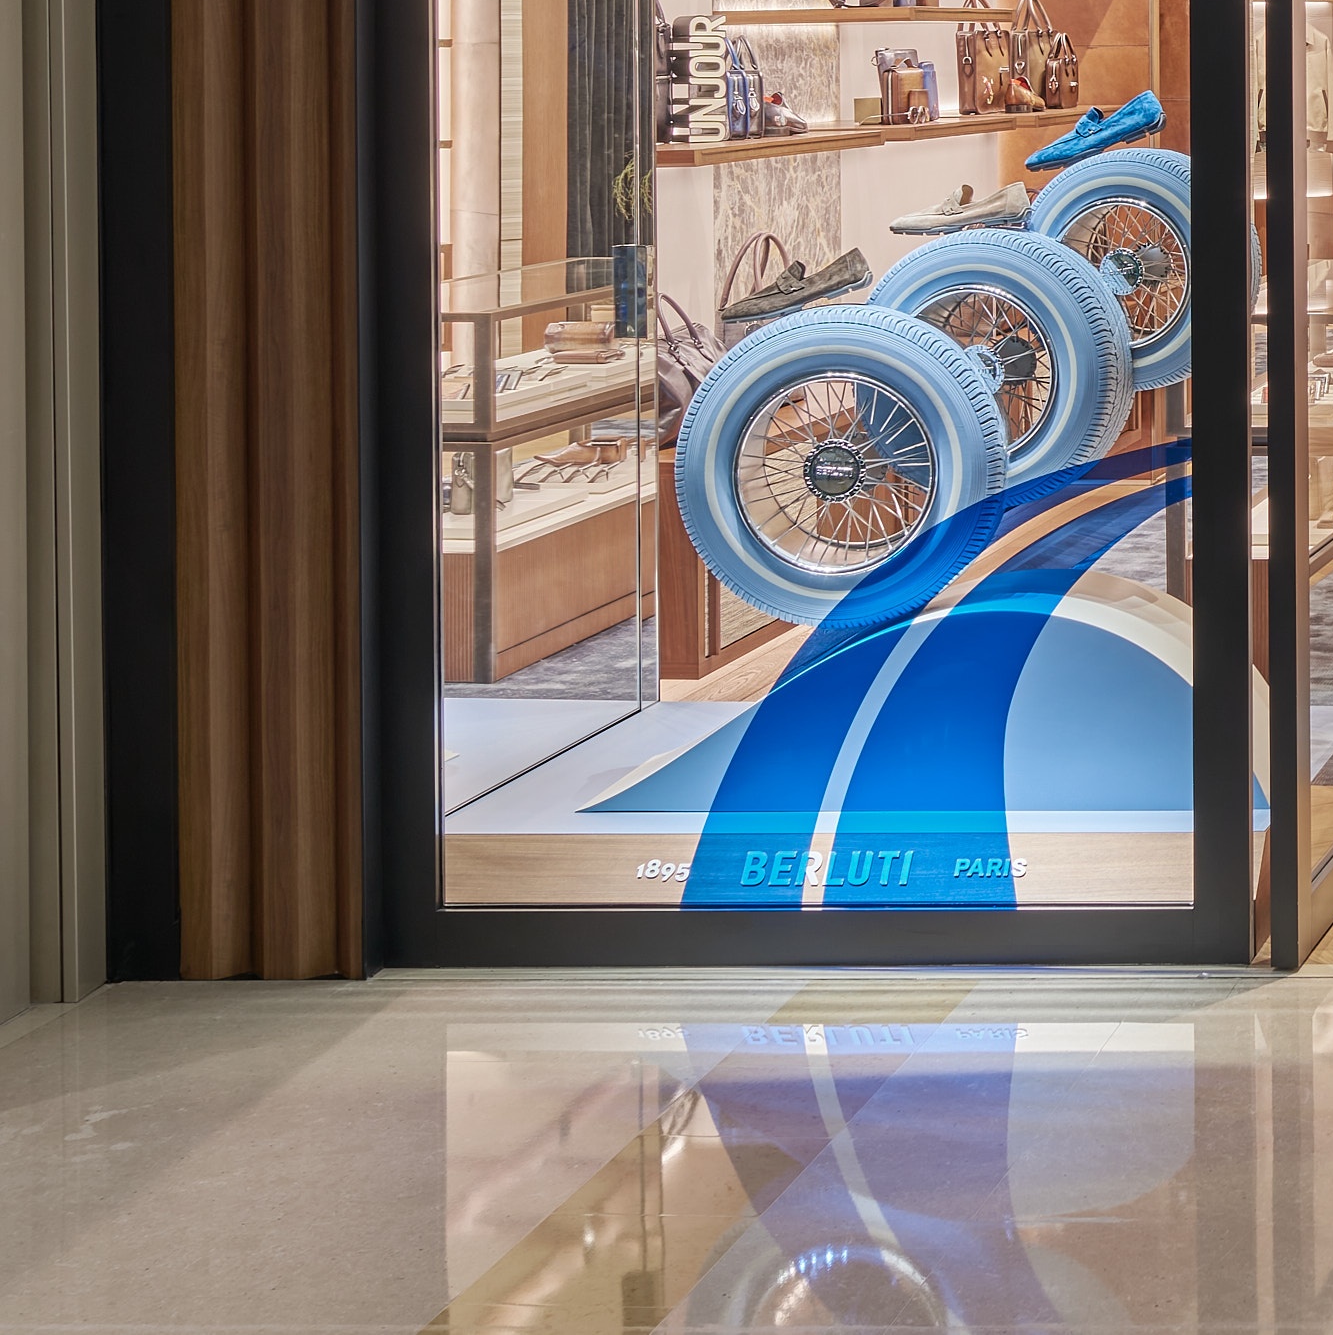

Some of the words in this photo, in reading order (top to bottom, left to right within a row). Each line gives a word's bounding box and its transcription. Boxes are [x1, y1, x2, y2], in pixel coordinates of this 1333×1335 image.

[636, 858, 691, 882] 1895
[739, 850, 915, 887] BERLUTI
[953, 858, 1028, 879] PARIS
